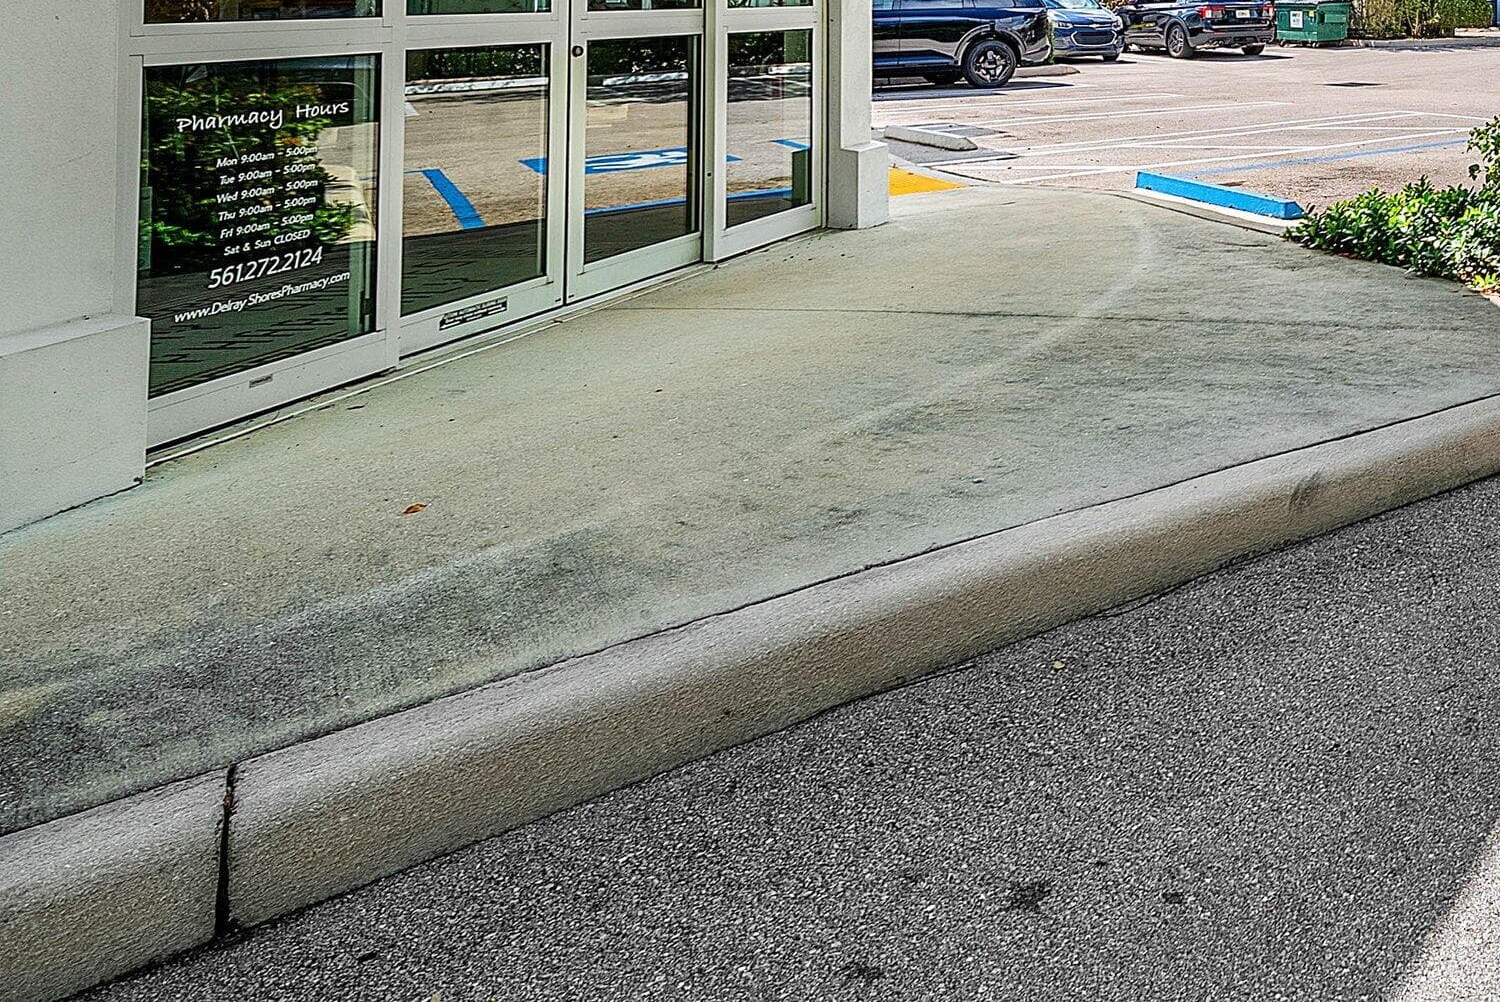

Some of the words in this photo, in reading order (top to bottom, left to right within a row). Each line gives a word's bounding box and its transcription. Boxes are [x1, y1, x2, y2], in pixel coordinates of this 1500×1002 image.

[176, 109, 283, 133] Pharmacy
[296, 101, 350, 119] Hours
[216, 157, 238, 168] Mon
[240, 151, 275, 164] 9:00am
[285, 145, 318, 158] 5:00pm
[219, 174, 236, 186] Tue
[237, 169, 272, 183] 9:00am
[283, 162, 315, 175] 5:00pm
[216, 191, 238, 204] Wed
[240, 186, 275, 199] 9:00am
[285, 179, 318, 191] 5:00pm
[218, 210, 236, 222] Thu
[238, 204, 273, 217] 9:00am
[283, 196, 316, 209] 5:00pm
[219, 227, 233, 240] Fri
[235, 222, 270, 236] 9:00am
[281, 213, 314, 227] 5:00pm
[223, 246, 240, 256] Sat
[242, 242, 251, 252] &
[254, 239, 272, 250] Sun
[273, 229, 311, 245] CLOSED
[208, 245, 323, 289] 561.272.2124
